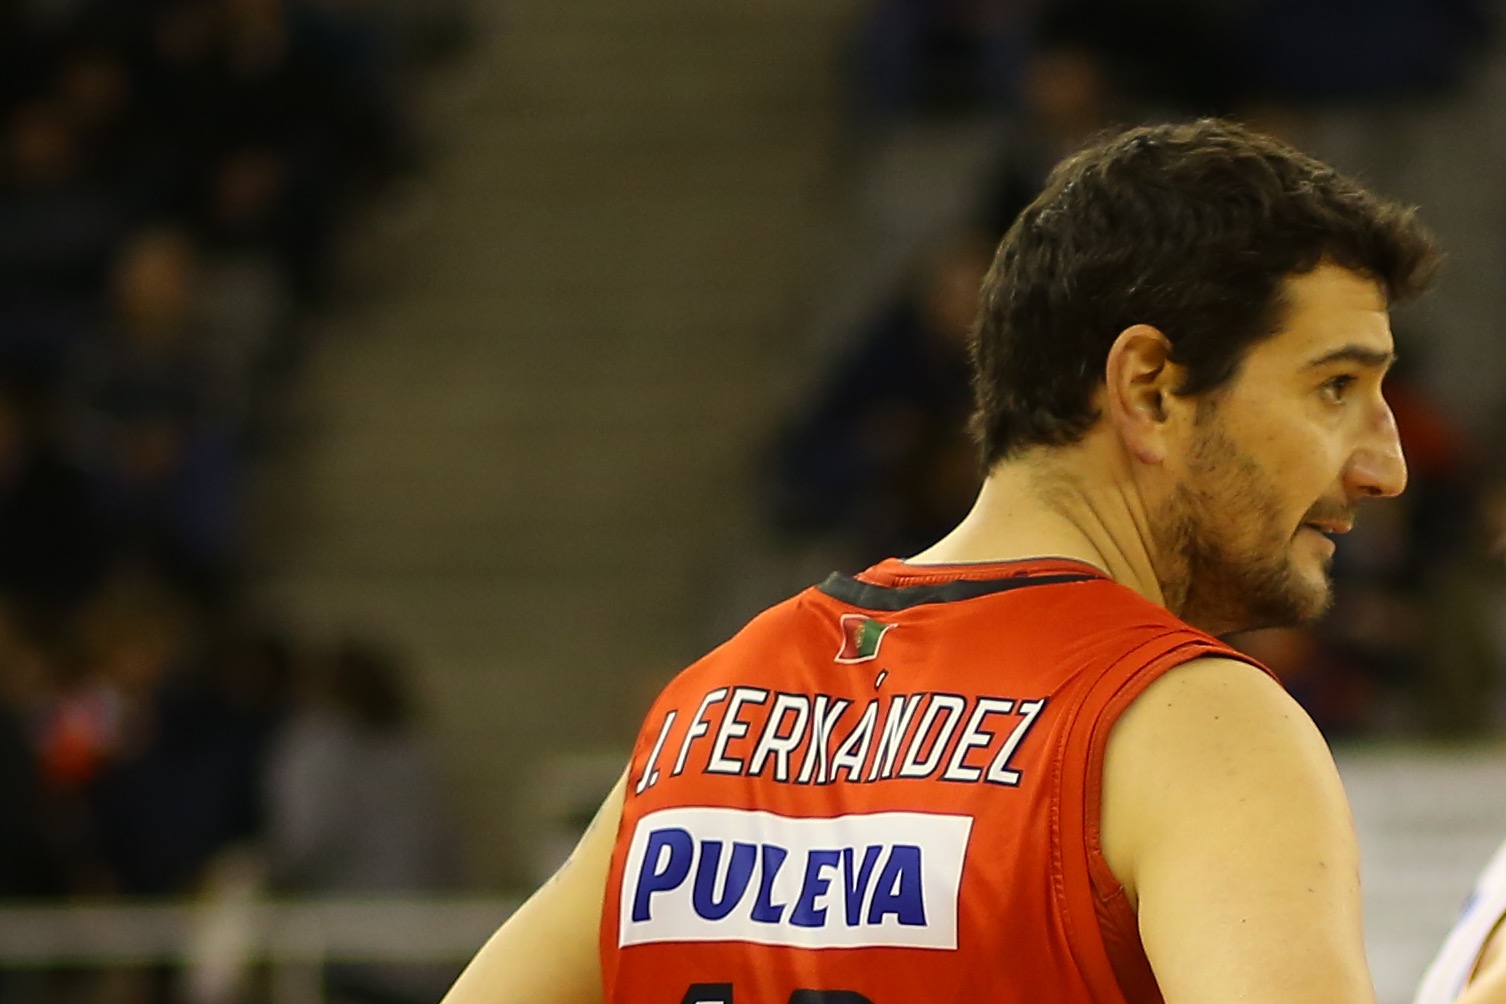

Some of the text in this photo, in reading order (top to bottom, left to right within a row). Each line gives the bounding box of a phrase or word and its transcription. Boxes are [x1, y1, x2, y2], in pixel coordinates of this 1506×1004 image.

[635, 670, 1047, 797] J. FERNÁNDEZ
[631, 827, 929, 928] PULEVA
